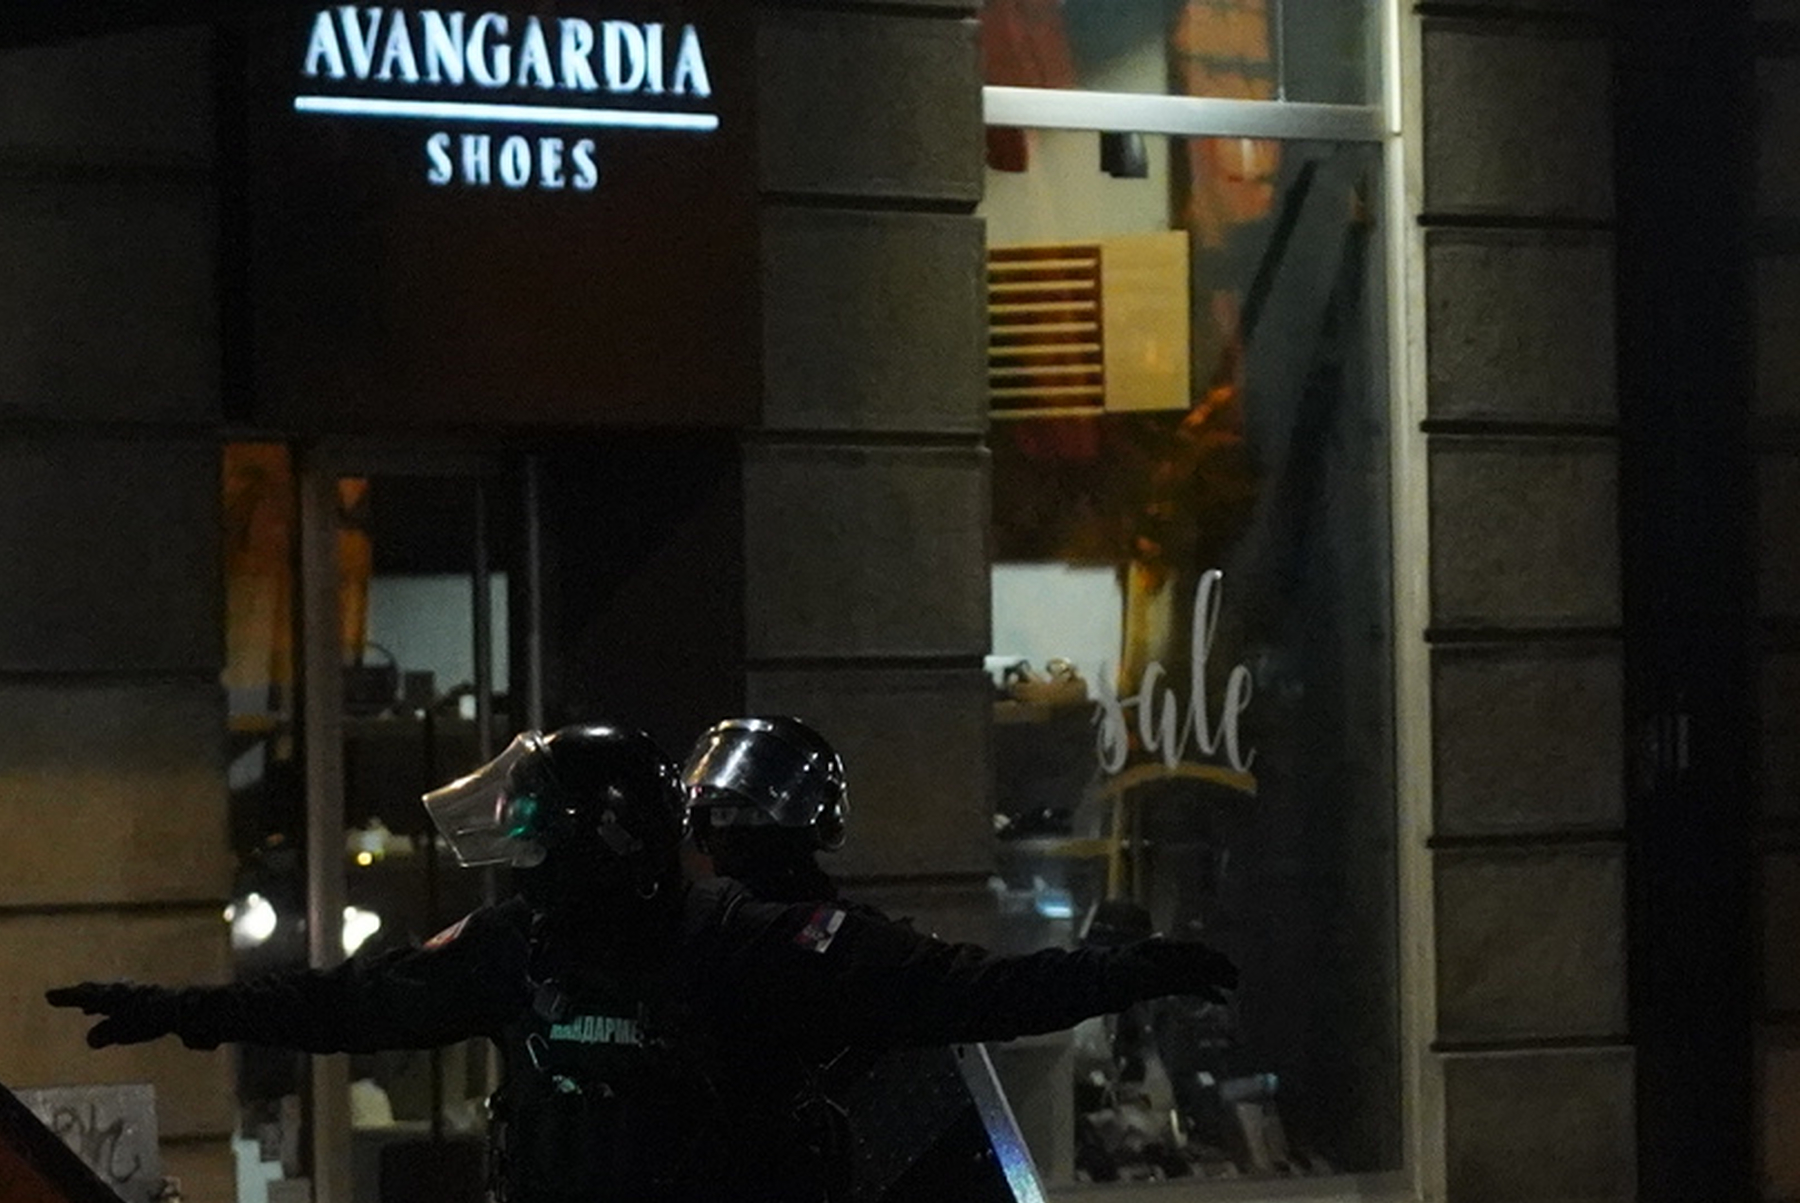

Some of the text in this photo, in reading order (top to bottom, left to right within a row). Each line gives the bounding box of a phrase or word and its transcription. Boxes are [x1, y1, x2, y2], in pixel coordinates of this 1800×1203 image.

[300, 5, 712, 98] AVANGARDIA
[425, 130, 599, 190] SHOES
[1090, 568, 1257, 774] sale
